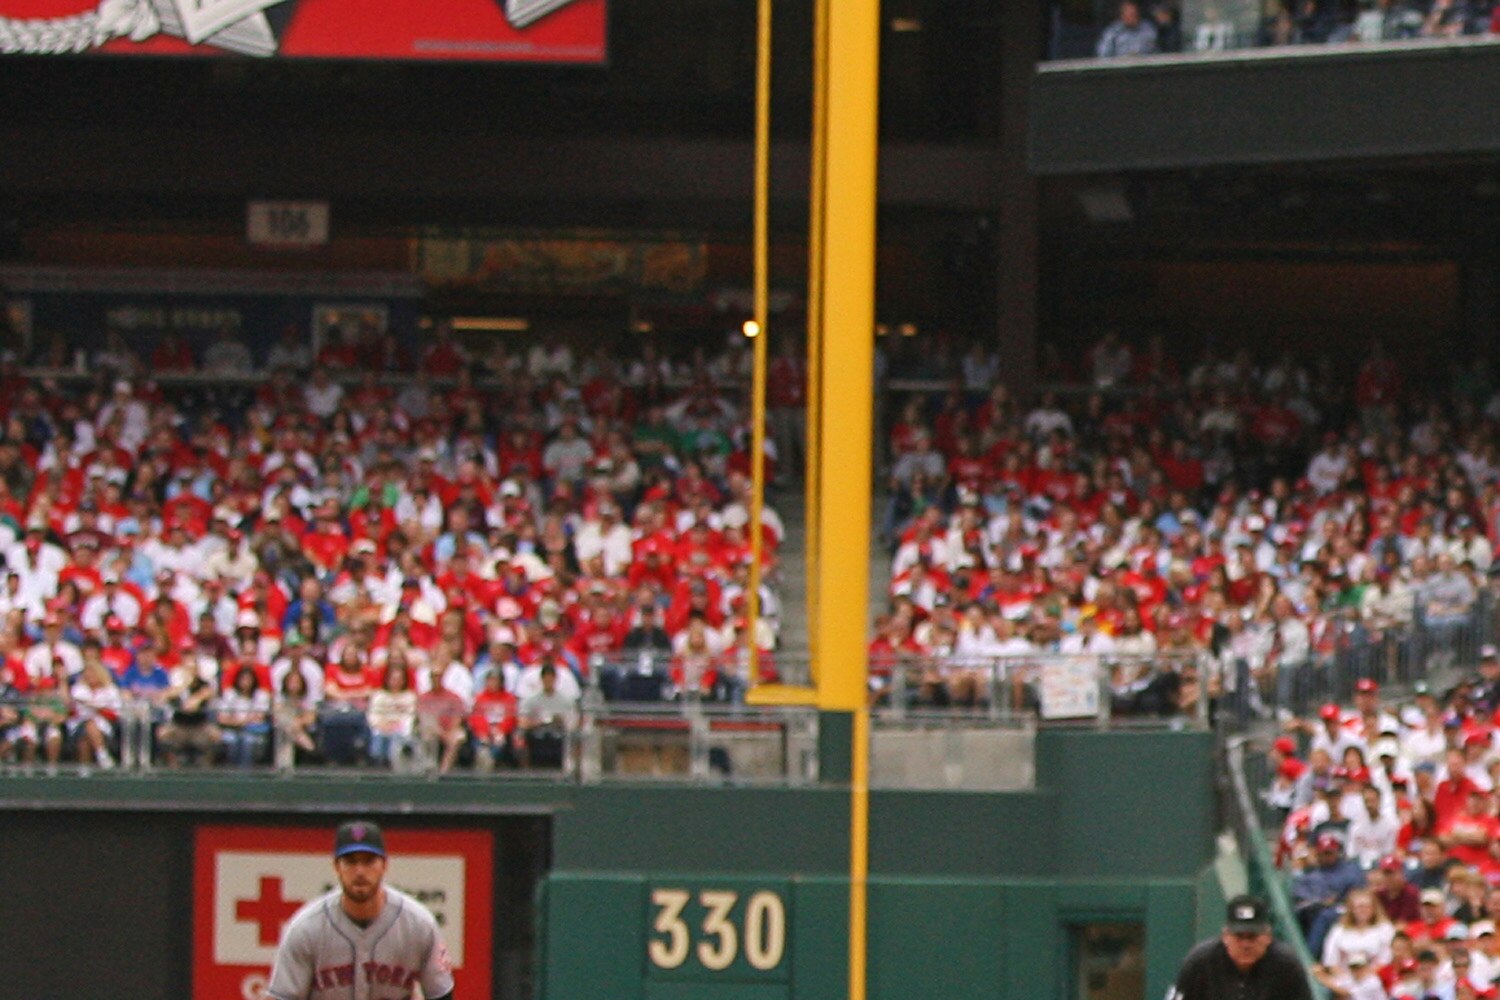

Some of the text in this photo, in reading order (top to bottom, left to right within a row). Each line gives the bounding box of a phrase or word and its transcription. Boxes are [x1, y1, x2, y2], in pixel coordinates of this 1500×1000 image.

[648, 888, 786, 970] 330
[313, 961, 421, 991] NEW YORK
